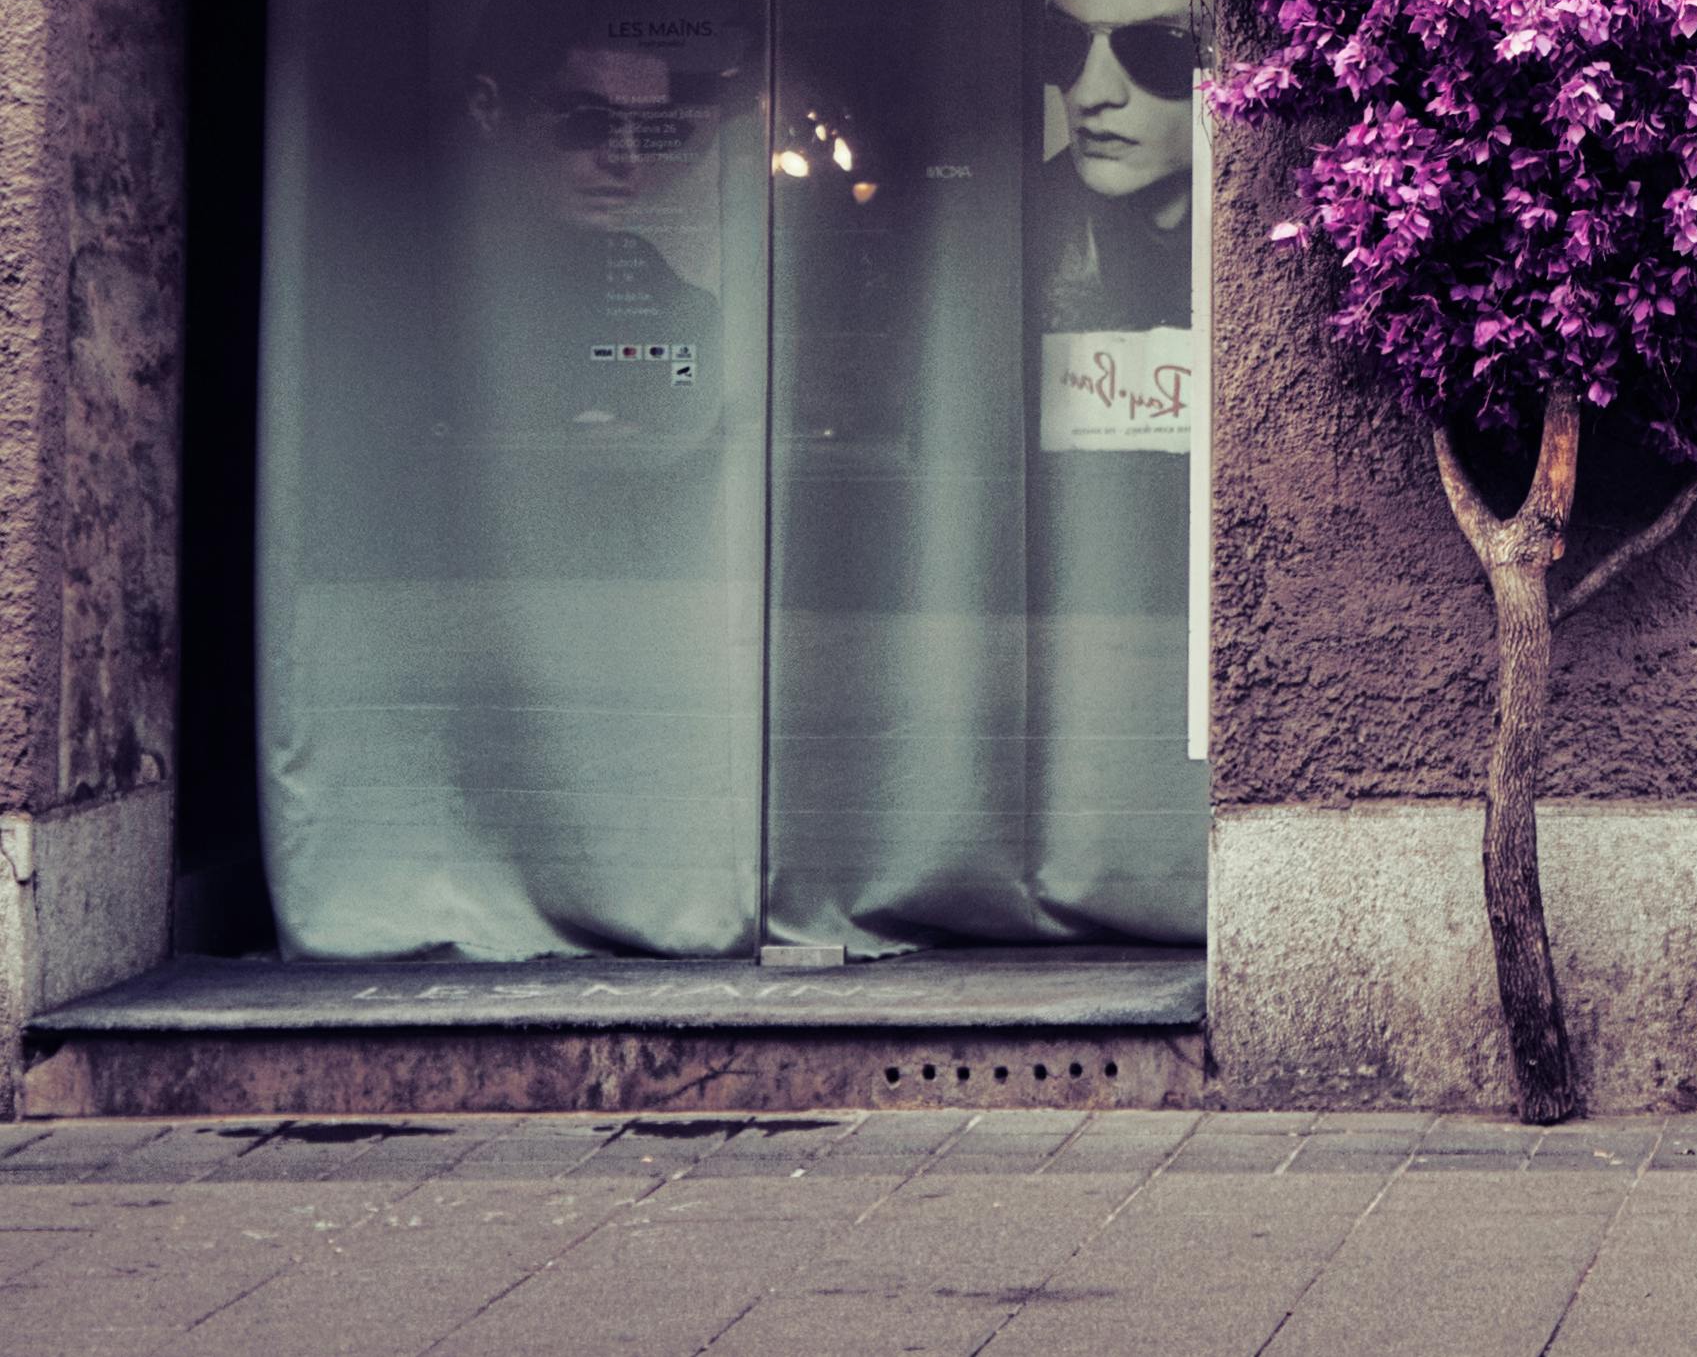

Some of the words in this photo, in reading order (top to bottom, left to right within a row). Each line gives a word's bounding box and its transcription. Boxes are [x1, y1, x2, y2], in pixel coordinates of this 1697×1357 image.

[608, 22, 643, 38] LES
[662, 124, 677, 134] 26
[642, 138, 682, 150] Zagreb
[593, 349, 613, 357] VISA
